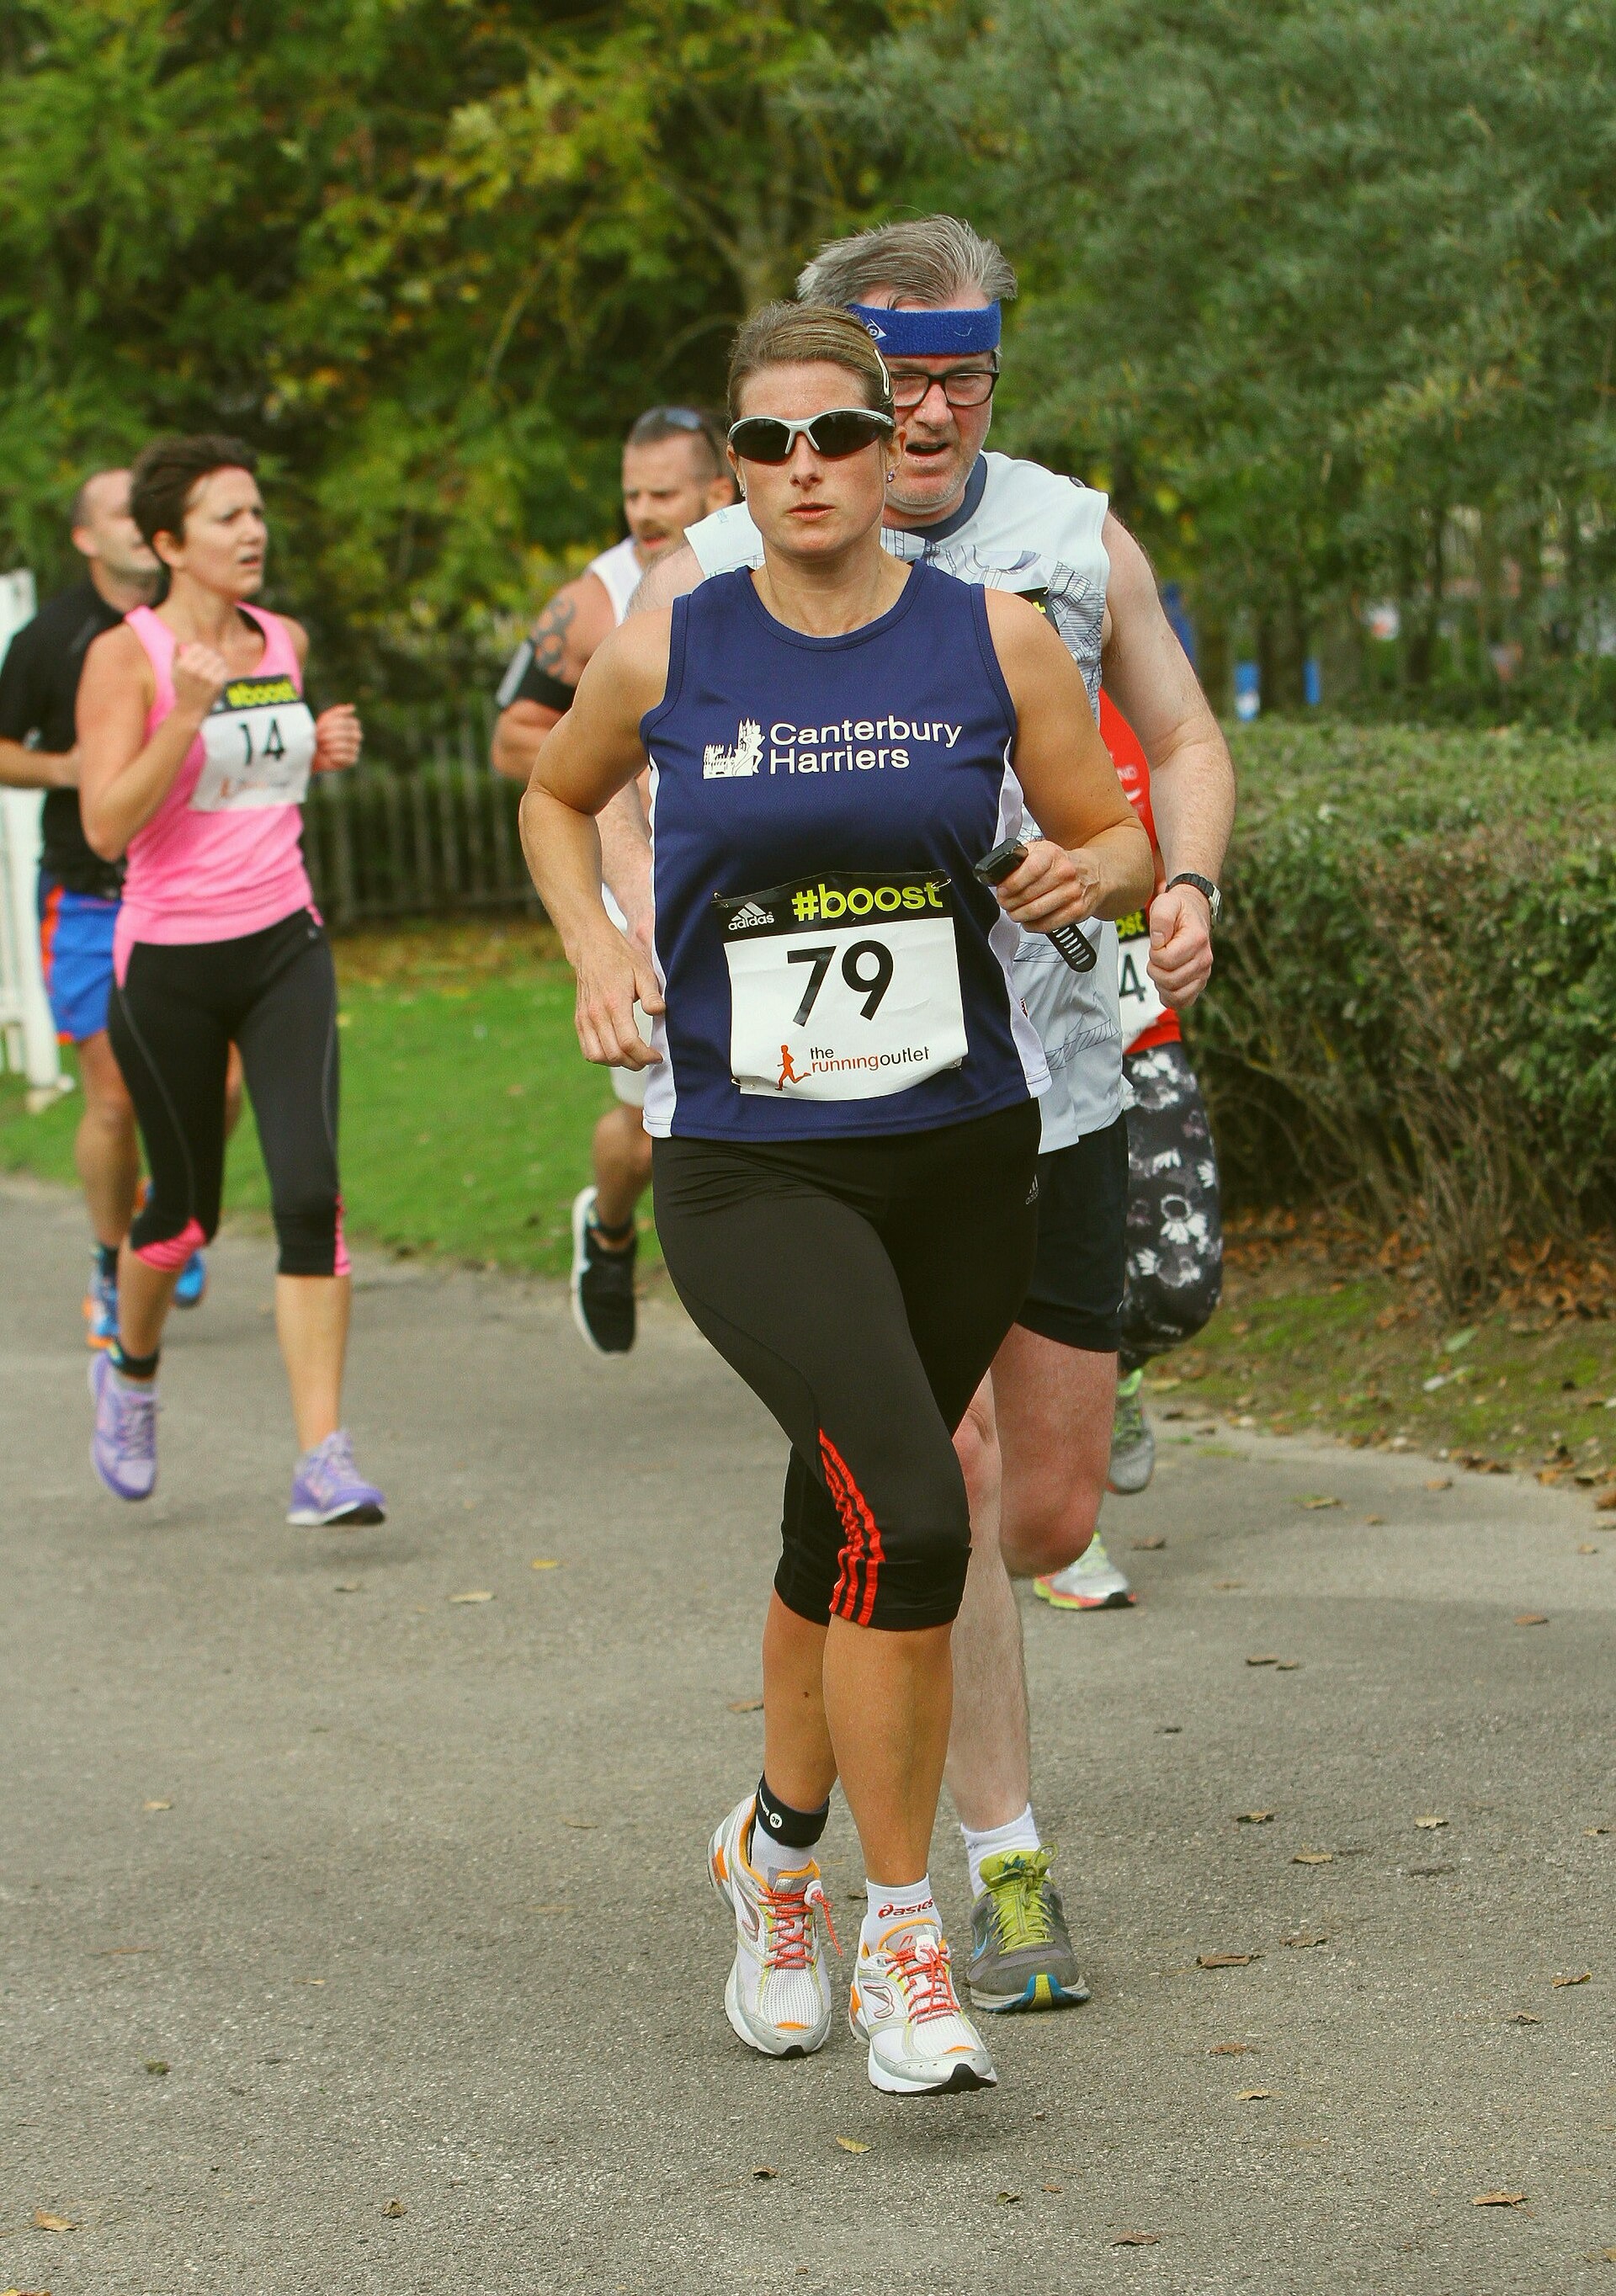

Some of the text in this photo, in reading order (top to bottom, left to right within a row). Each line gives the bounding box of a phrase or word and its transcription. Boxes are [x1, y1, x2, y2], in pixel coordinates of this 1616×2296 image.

[226, 678, 299, 708] #boost
[240, 718, 285, 765] 14
[769, 715, 963, 748] Canterbury
[769, 745, 910, 775] Harriers
[791, 882, 944, 922] #boost
[728, 915, 774, 931] adidas
[1116, 911, 1146, 938] ost
[787, 940, 894, 1027] 79
[810, 1046, 834, 1060] the
[878, 1898, 933, 1918] asics
